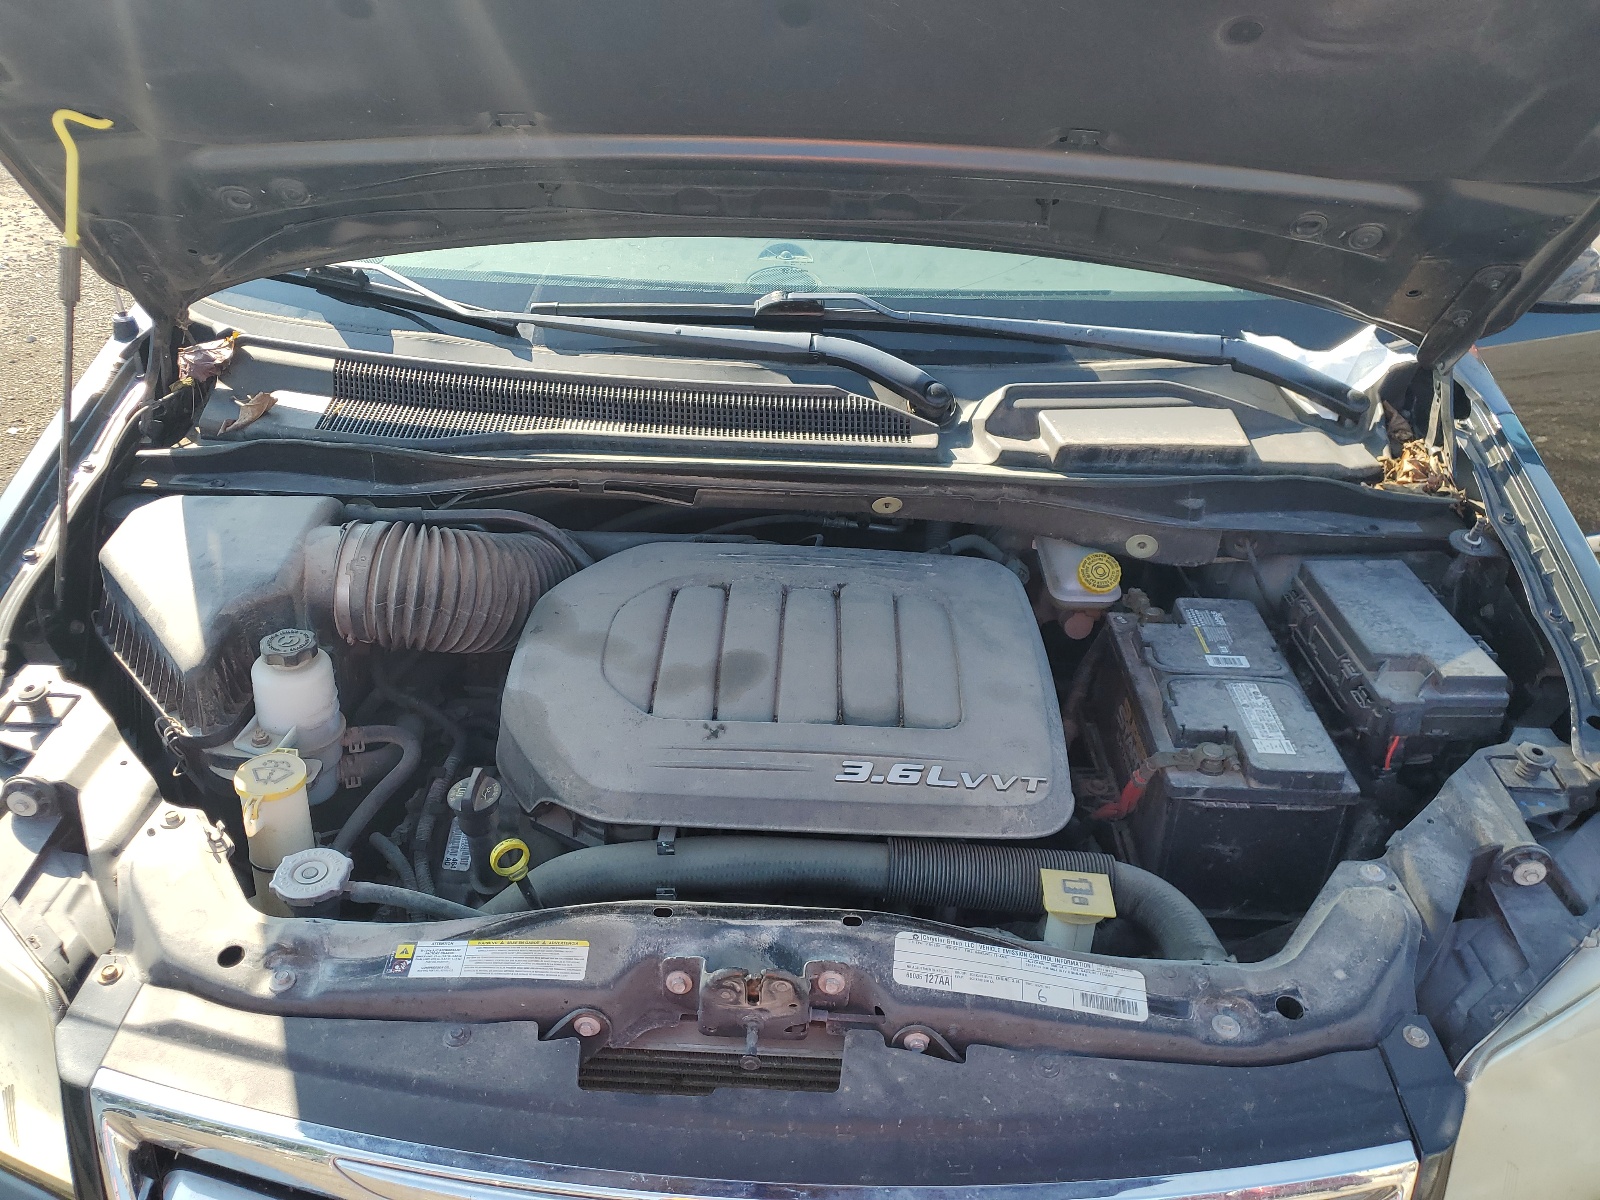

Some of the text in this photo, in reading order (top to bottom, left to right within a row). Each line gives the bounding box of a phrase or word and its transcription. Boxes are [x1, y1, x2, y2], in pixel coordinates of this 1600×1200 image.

[979, 944, 1001, 953] VEHICLE
[1002, 948, 1028, 958] EMISSION
[1028, 952, 1052, 962] CONTROL
[1054, 957, 1091, 968] INFORMATION
[924, 974, 950, 986] 127AA
[1037, 988, 1048, 1003] 6
